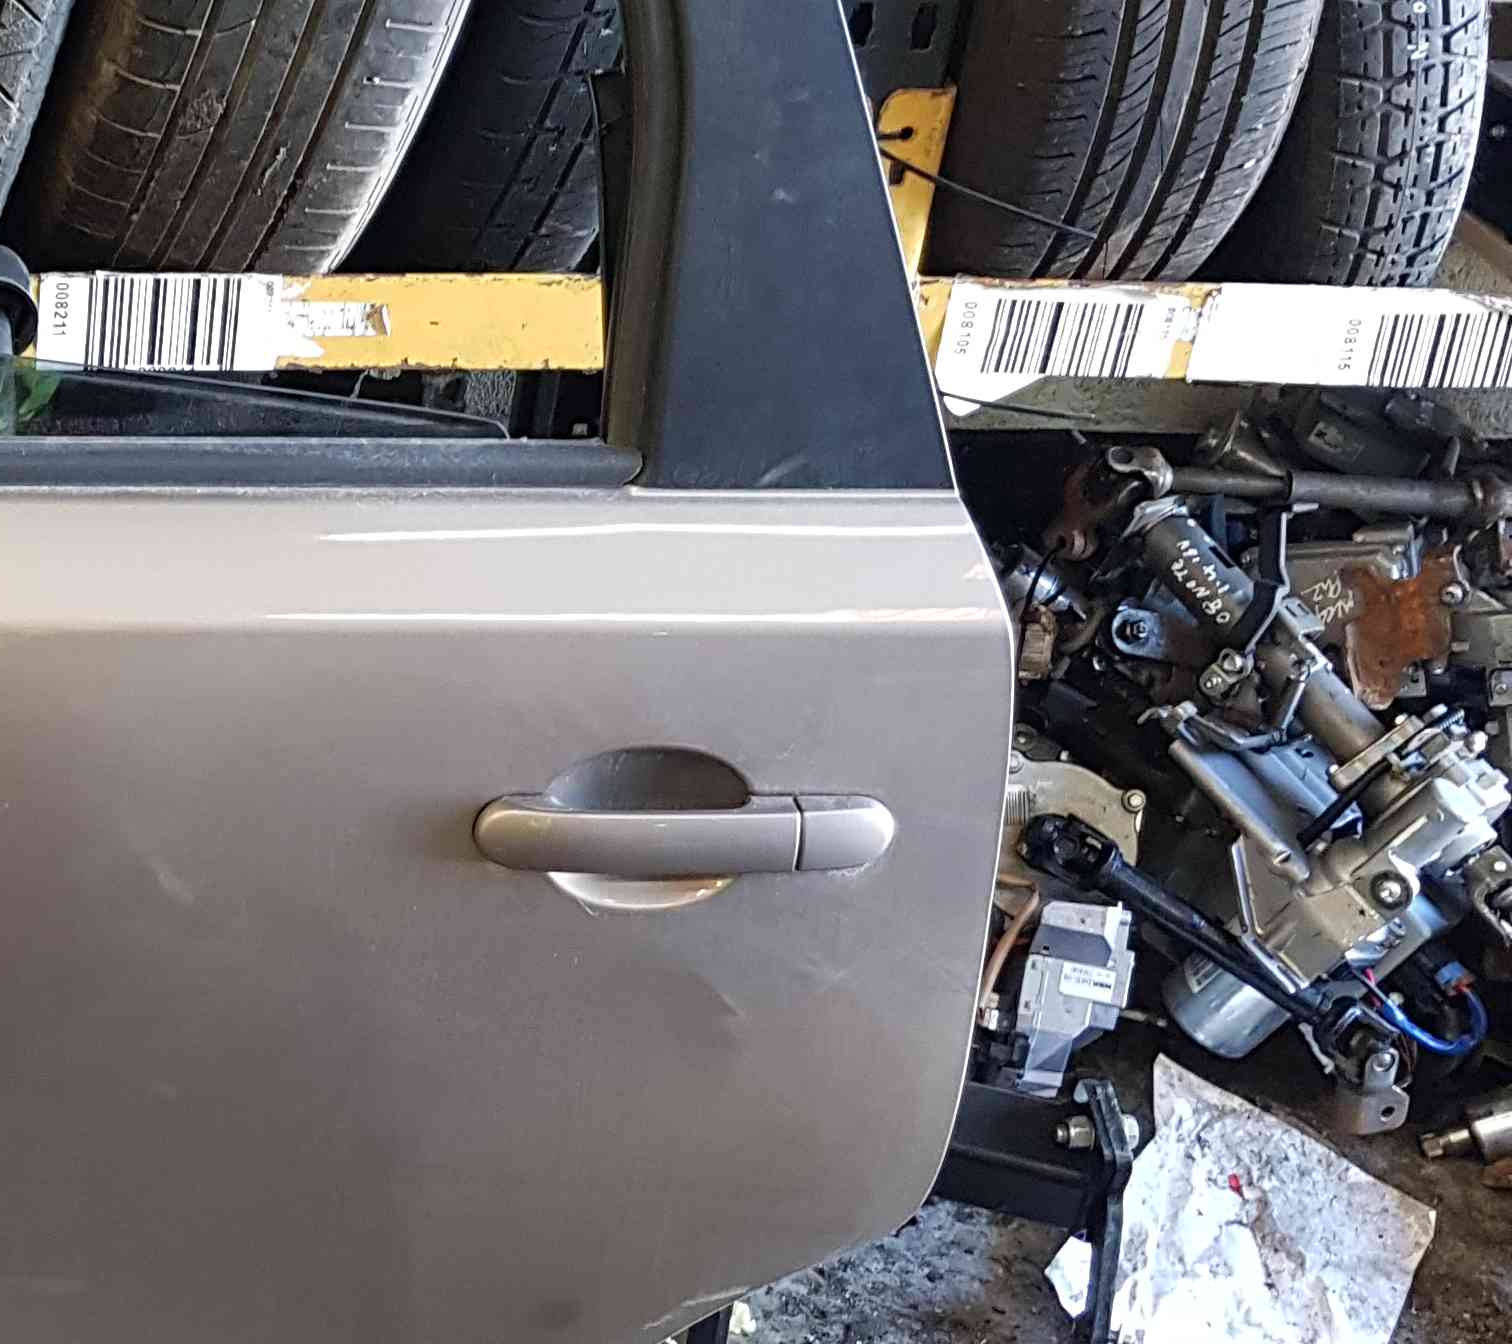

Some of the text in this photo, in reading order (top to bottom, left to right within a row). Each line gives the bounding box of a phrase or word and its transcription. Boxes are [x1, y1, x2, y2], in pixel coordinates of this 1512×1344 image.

[51, 282, 70, 336] 008211
[953, 301, 978, 355] 008105
[1337, 319, 1362, 371] 008115
